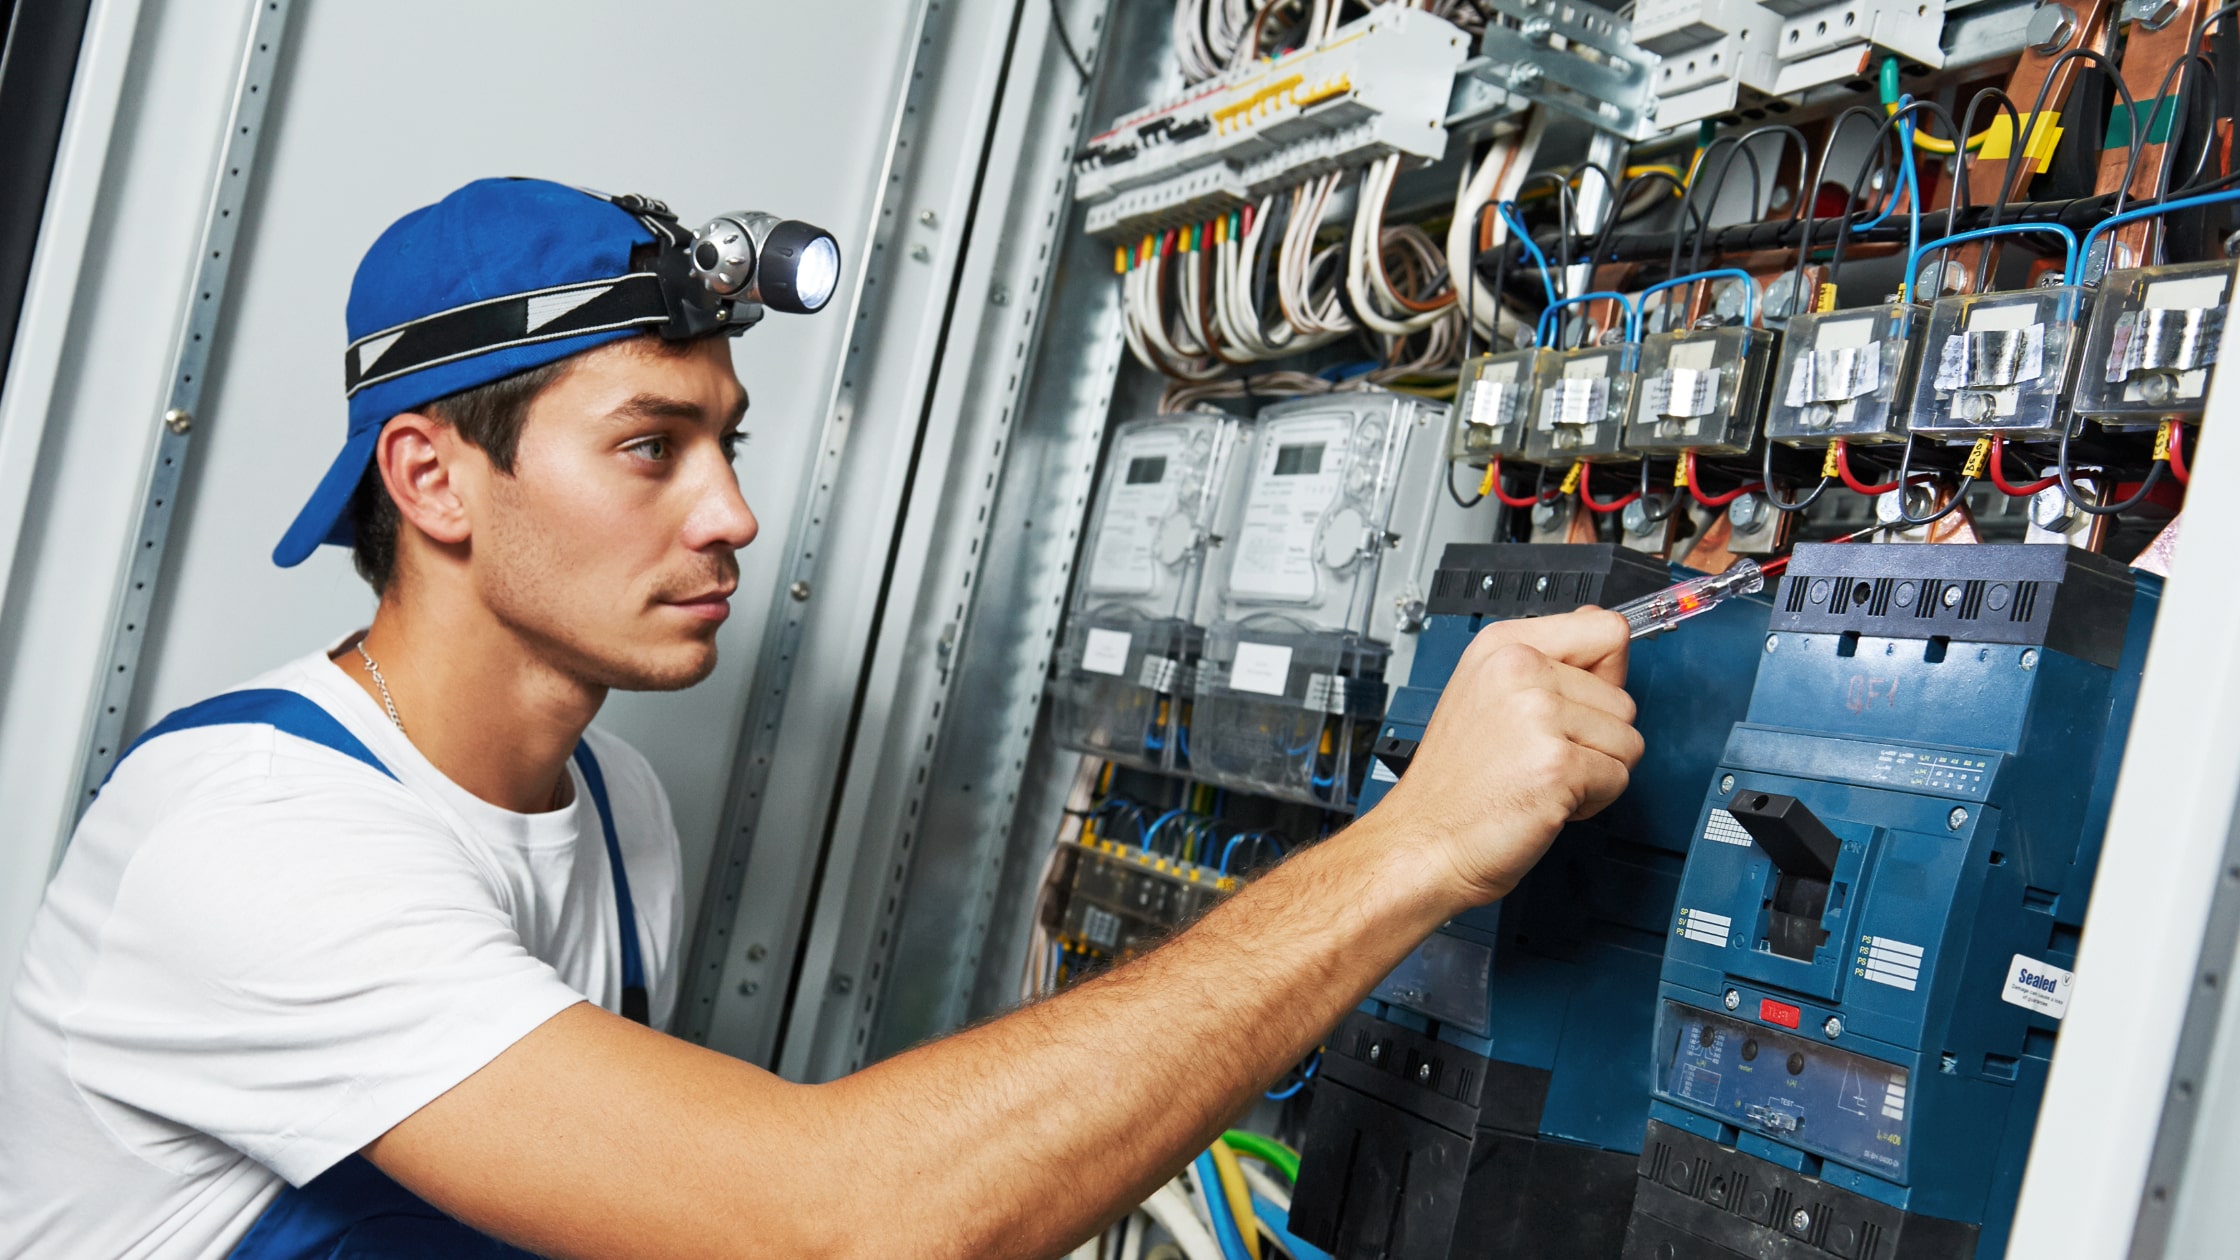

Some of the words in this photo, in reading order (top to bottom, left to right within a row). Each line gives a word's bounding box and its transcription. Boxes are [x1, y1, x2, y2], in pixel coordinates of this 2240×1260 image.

[1676, 927, 1685, 936] PS
[1862, 935, 1871, 944] PS
[1859, 946, 1869, 955] PS
[1857, 957, 1866, 966] PS
[1854, 967, 1864, 977] PS
[2019, 968, 2057, 993] Sealed
[1780, 1097, 1794, 1107] TEST
